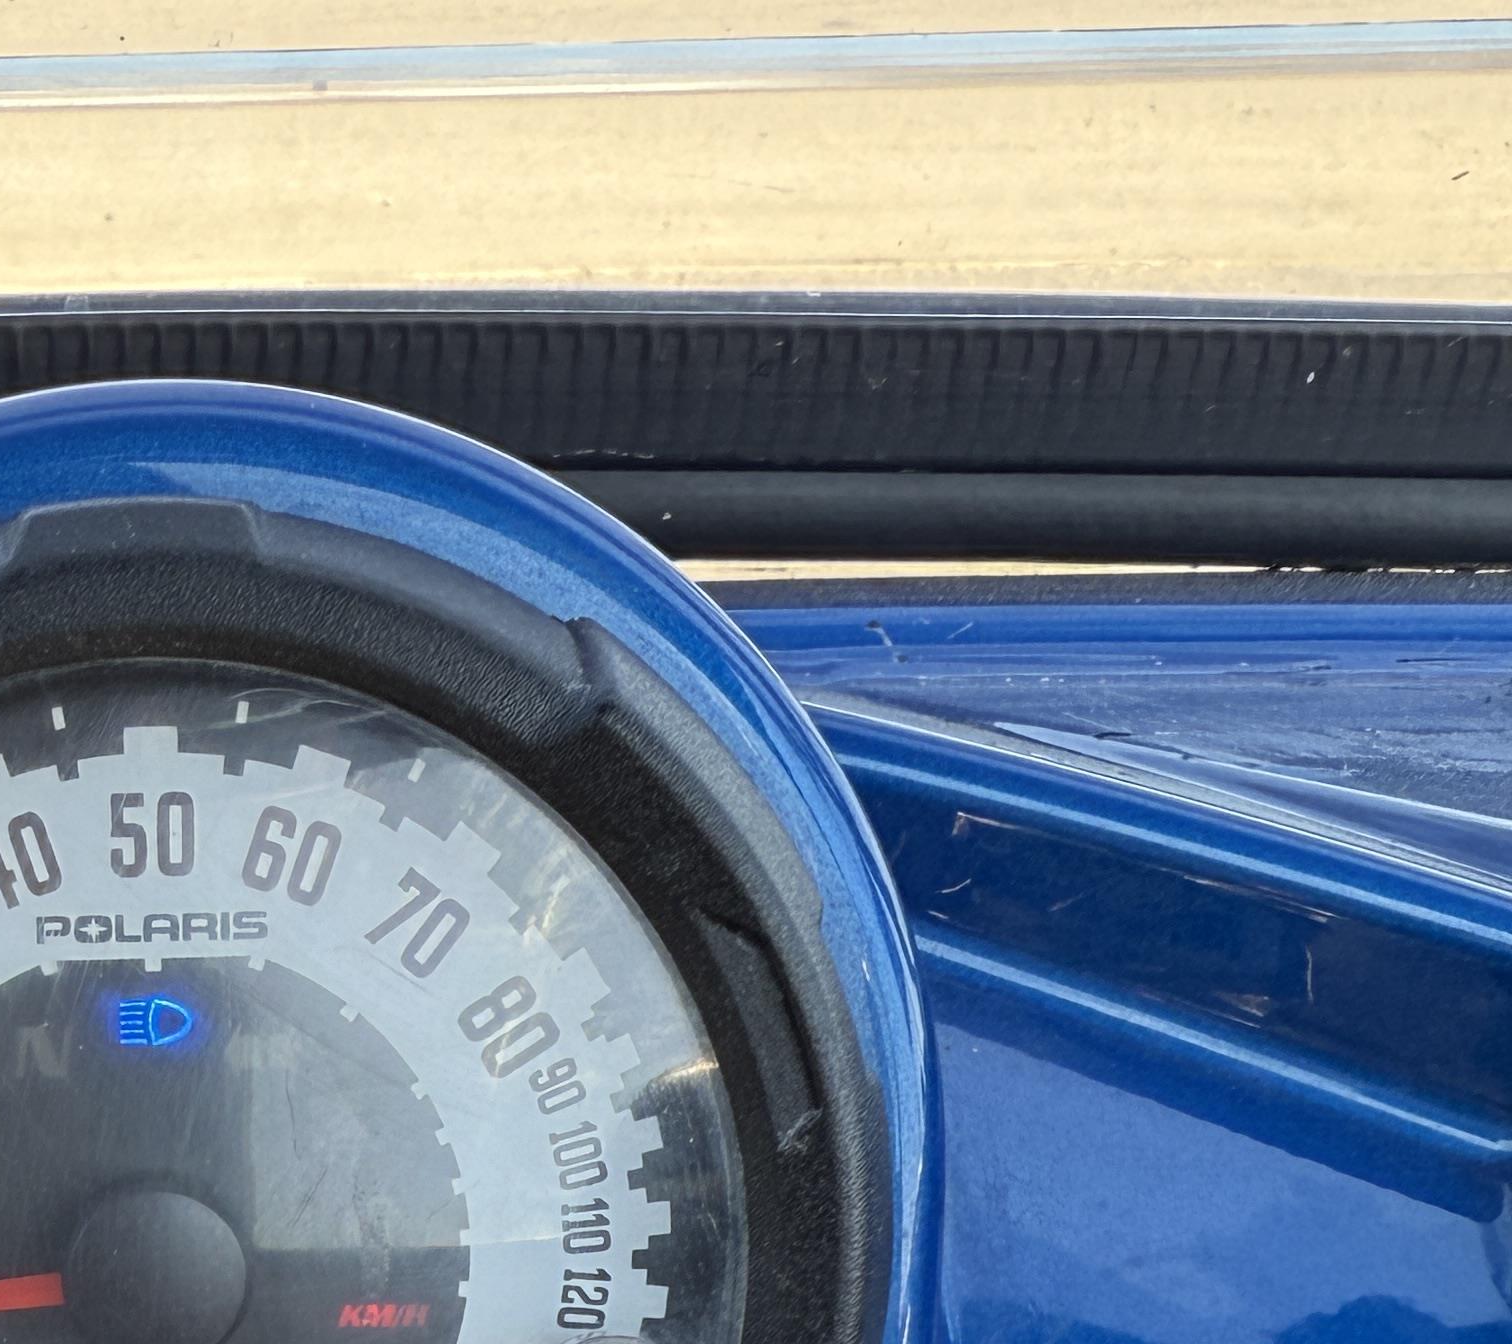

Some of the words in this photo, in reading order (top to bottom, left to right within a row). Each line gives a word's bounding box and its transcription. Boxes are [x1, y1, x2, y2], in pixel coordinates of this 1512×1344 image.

[110, 792, 194, 877] 50
[242, 806, 342, 906] 60
[36, 911, 268, 944] POLARIS
[365, 867, 470, 978] 70
[457, 976, 560, 1079] 80
[529, 1058, 587, 1115] 90
[549, 1120, 608, 1190] 100
[560, 1197, 611, 1254] 110
[339, 1303, 431, 1328] KM/H
[557, 1267, 609, 1330] 120
